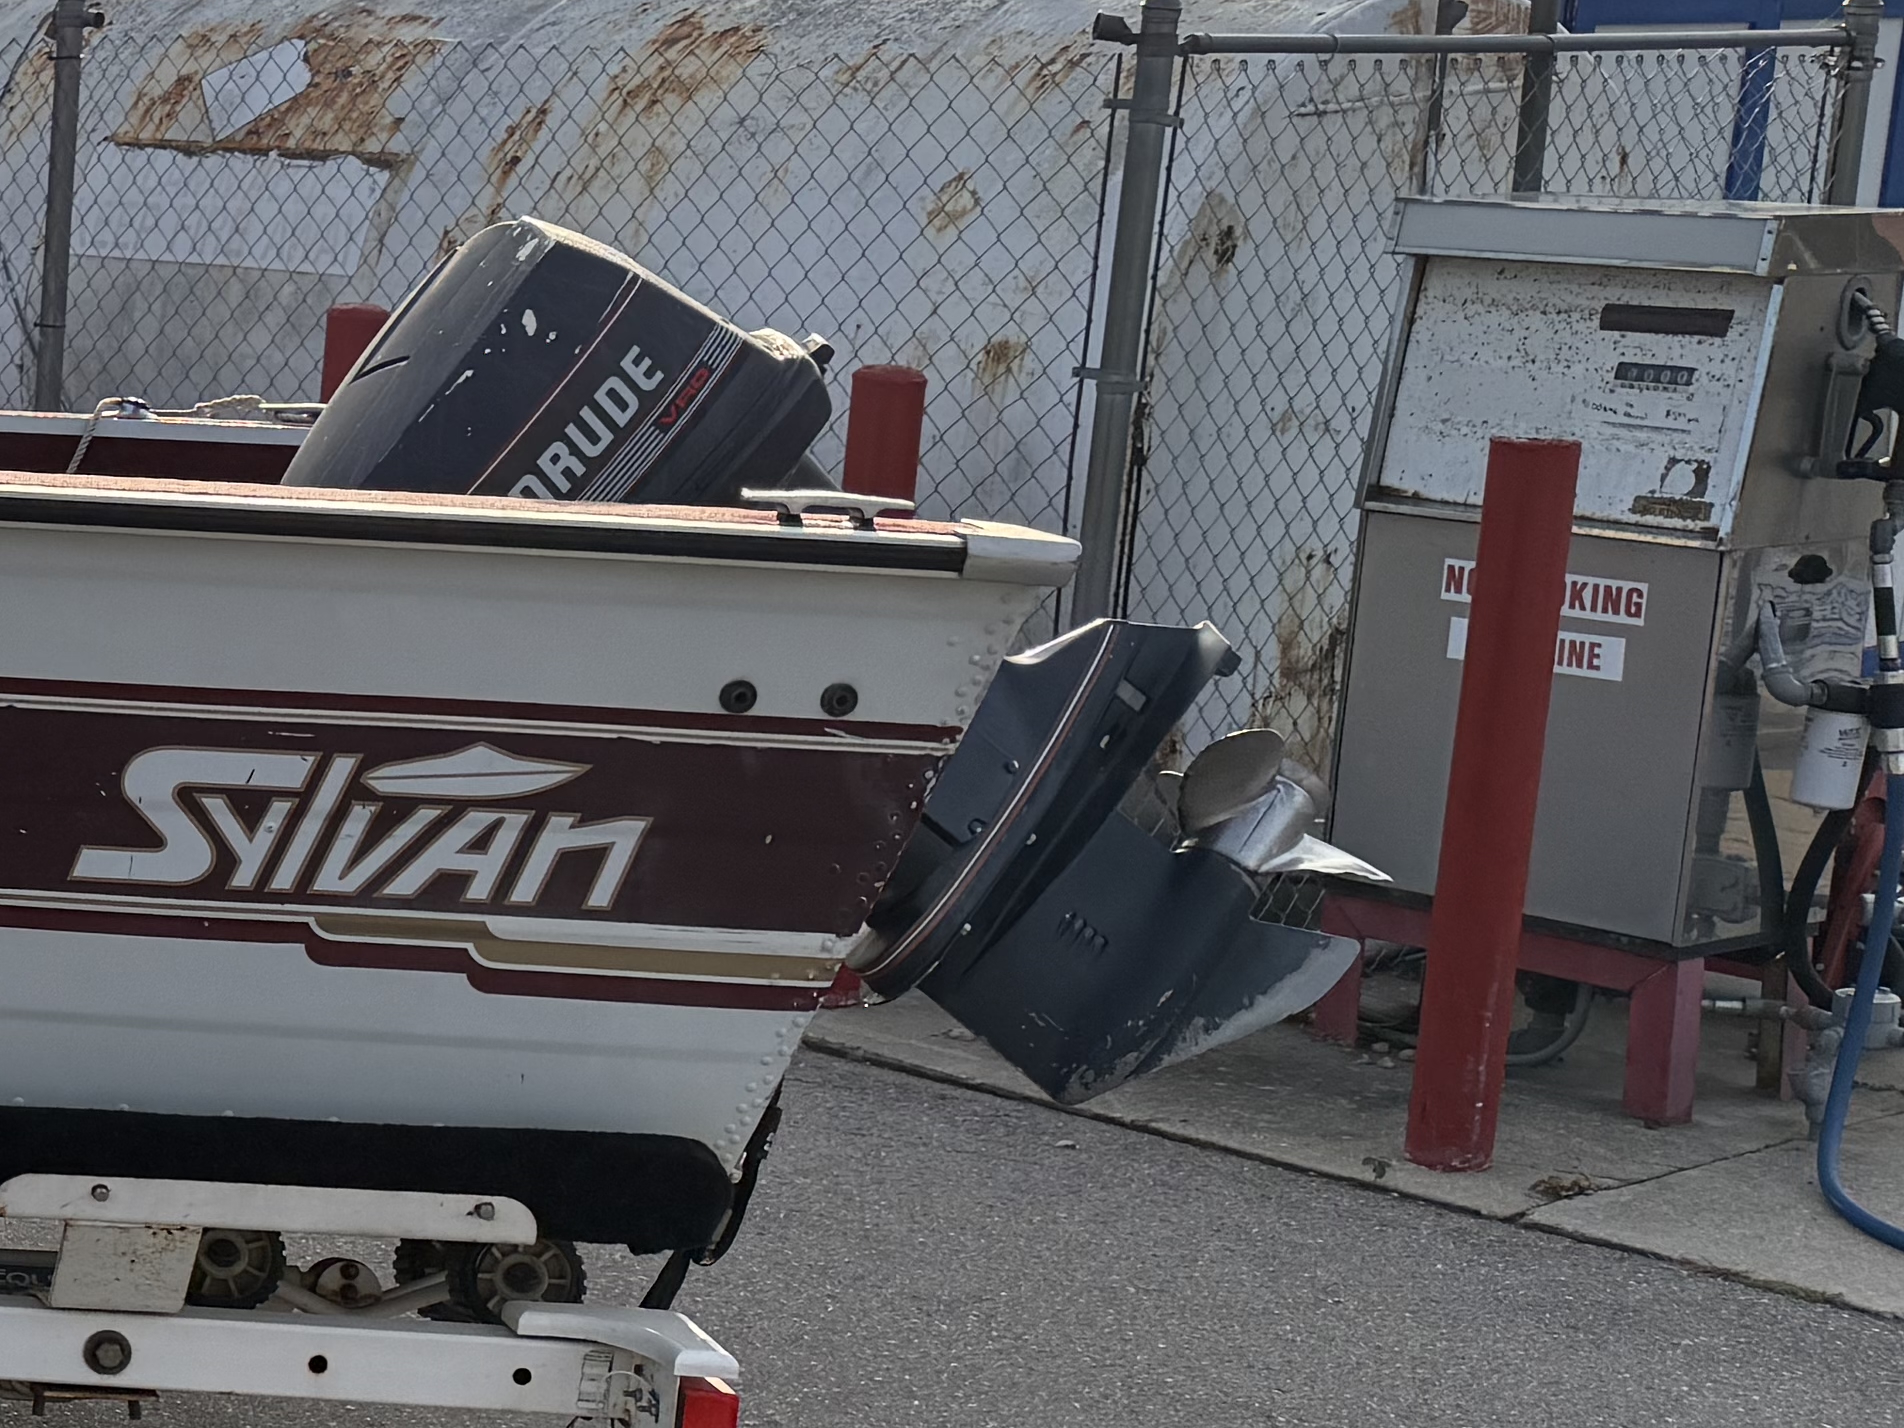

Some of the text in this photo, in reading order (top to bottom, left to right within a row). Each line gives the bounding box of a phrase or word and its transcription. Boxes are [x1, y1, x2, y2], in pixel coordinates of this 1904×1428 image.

[507, 345, 665, 501] RUDE
[1444, 564, 1645, 619] N KING
[1556, 638, 1603, 672] INE
